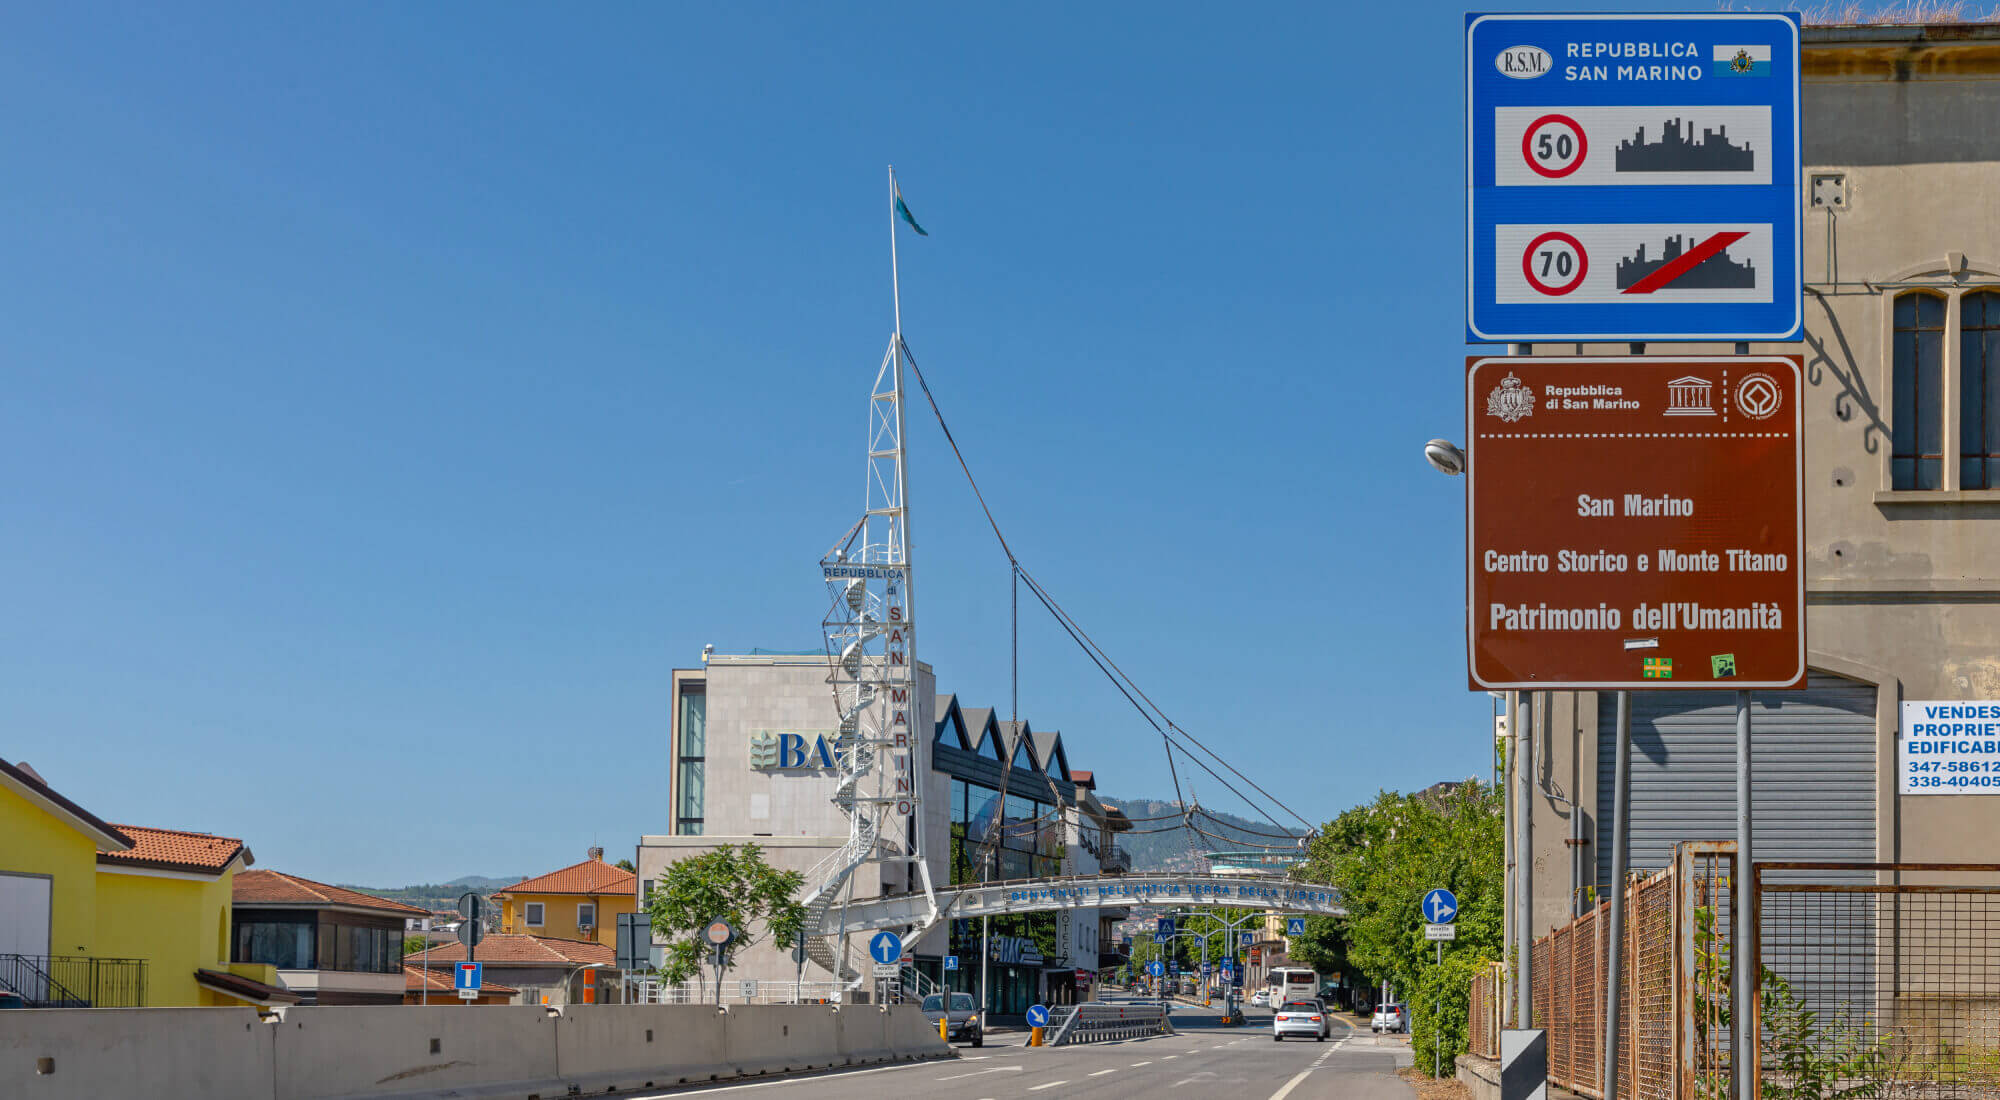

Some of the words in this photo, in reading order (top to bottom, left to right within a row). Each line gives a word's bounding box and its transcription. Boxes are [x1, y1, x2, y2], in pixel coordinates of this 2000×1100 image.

[1567, 43, 1698, 58] REPUBBLICA
[1504, 52, 1545, 72] R.S.M.
[1565, 65, 1608, 81] SAN
[1617, 65, 1702, 81] MARINO
[1537, 134, 1573, 160] 50
[1540, 251, 1573, 277] 70
[1545, 384, 1623, 398] Repubblica
[1670, 387, 1710, 407] UNESCO
[1545, 399, 1559, 410] di
[1562, 399, 1589, 410] San
[1593, 398, 1640, 410] Marino
[1577, 494, 1615, 517] San
[1624, 494, 1694, 517] Marino
[1484, 550, 1549, 573] Centro
[1557, 550, 1628, 573] Storico
[1637, 554, 1649, 572] e
[1658, 550, 1720, 573] Monte
[1725, 550, 1788, 573] Titano
[824, 568, 904, 578] REPUBBLICA
[888, 586, 896, 595] di
[1490, 603, 1621, 631] Patrimonio
[1632, 602, 1782, 631] dell'Umanità
[890, 607, 903, 665] SAN
[1925, 706, 2000, 719] VENDES
[892, 689, 911, 815] MARINO
[1909, 761, 2000, 773] 347-58612
[1909, 776, 2000, 787] 338-40405
[1011, 887, 1089, 901] BENVENUTI
[1187, 884, 1230, 895] TERRA
[1239, 886, 1278, 897] DELLA
